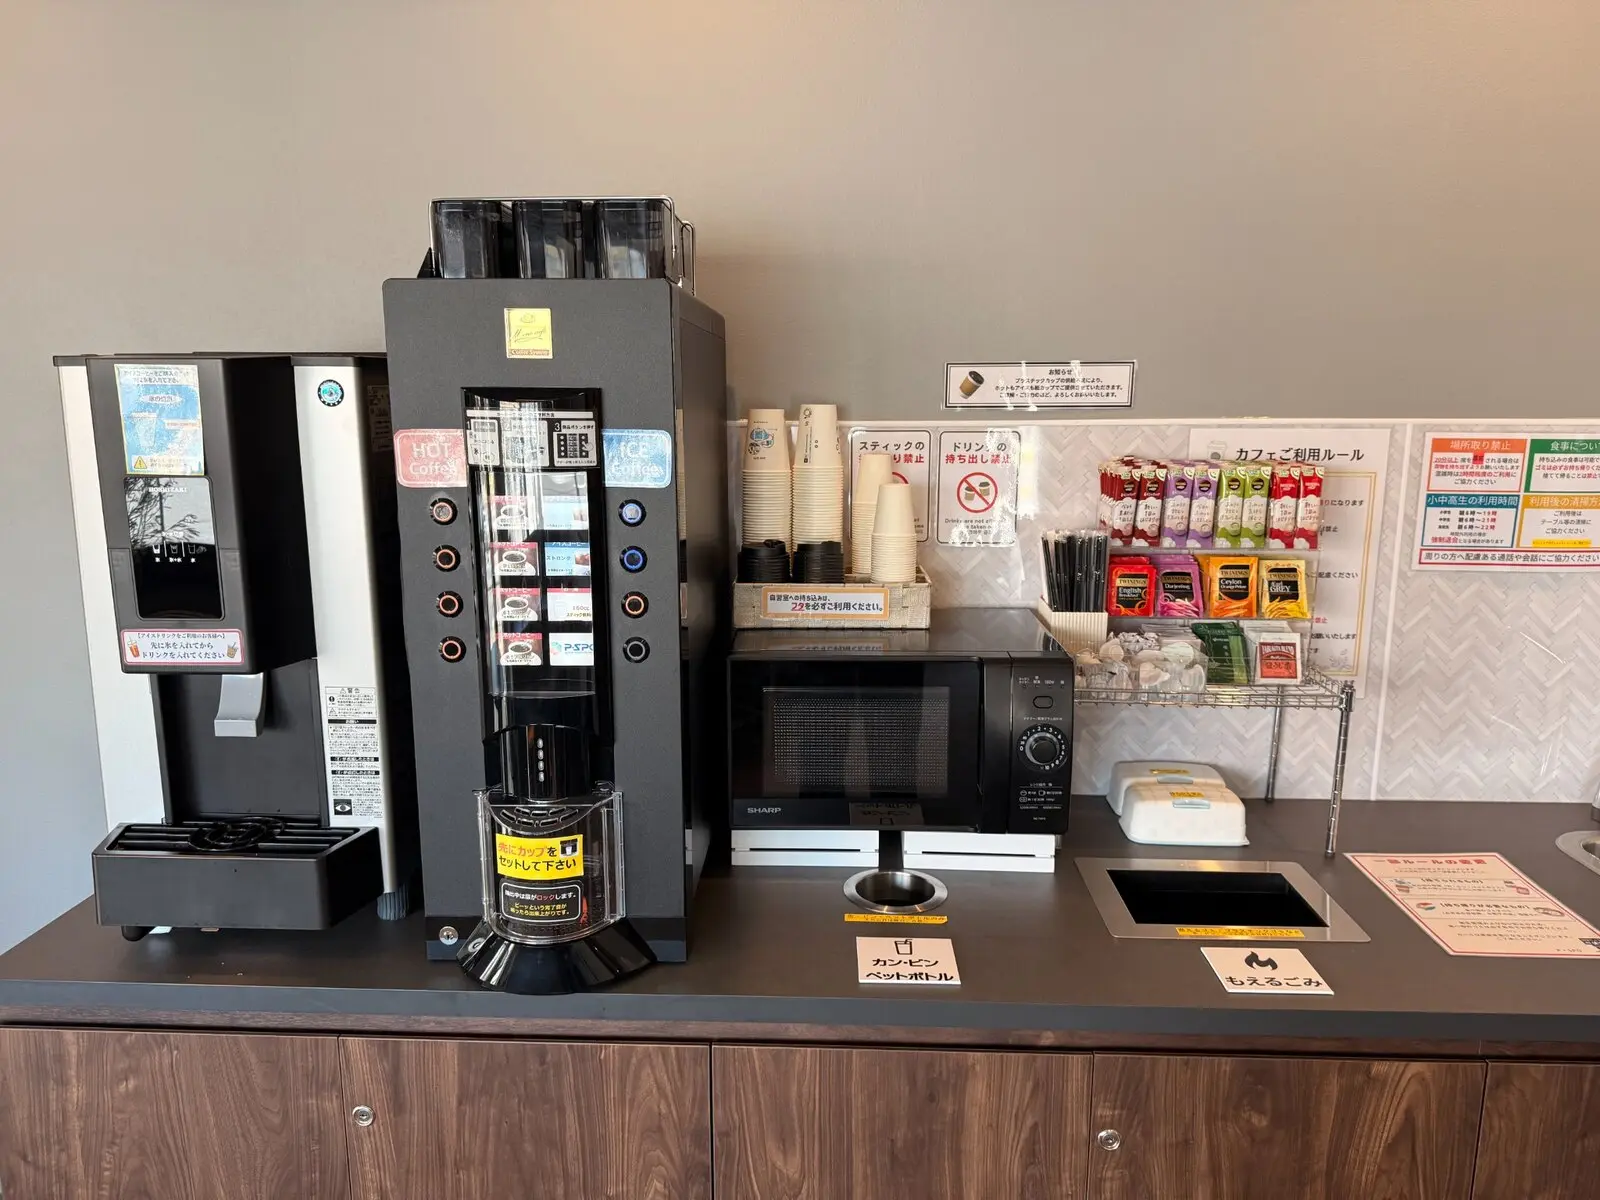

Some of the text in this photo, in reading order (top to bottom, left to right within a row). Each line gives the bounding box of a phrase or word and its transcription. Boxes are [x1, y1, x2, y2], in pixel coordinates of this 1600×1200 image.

[554, 422, 561, 431] 3
[412, 442, 452, 458] HOT
[859, 441, 925, 451] スティックの
[952, 442, 1007, 452] ドリンの
[1450, 440, 1511, 450] 場所取り禁止
[945, 454, 1011, 464] 持ち出し禁止
[1236, 448, 1364, 462] カフェご利用ルール
[1427, 495, 1518, 506] 小中高生の利用時間
[1424, 552, 1600, 562] 周りの方へ配慮ある通話や会話にご協力ください
[1119, 587, 1141, 595] English
[770, 594, 831, 602] 自習室への持ち込みは、
[791, 602, 883, 612] フタを必ずご利用ください。
[150, 641, 214, 649] 先に氷を入れてから
[142, 651, 225, 659] ドリンクを入れてください
[498, 842, 557, 857] 先にカップを
[499, 856, 577, 871] セットして下さい
[872, 958, 939, 967] カン・ビン
[866, 972, 954, 981] ペットボトル
[1225, 976, 1323, 987] もえるごみ
